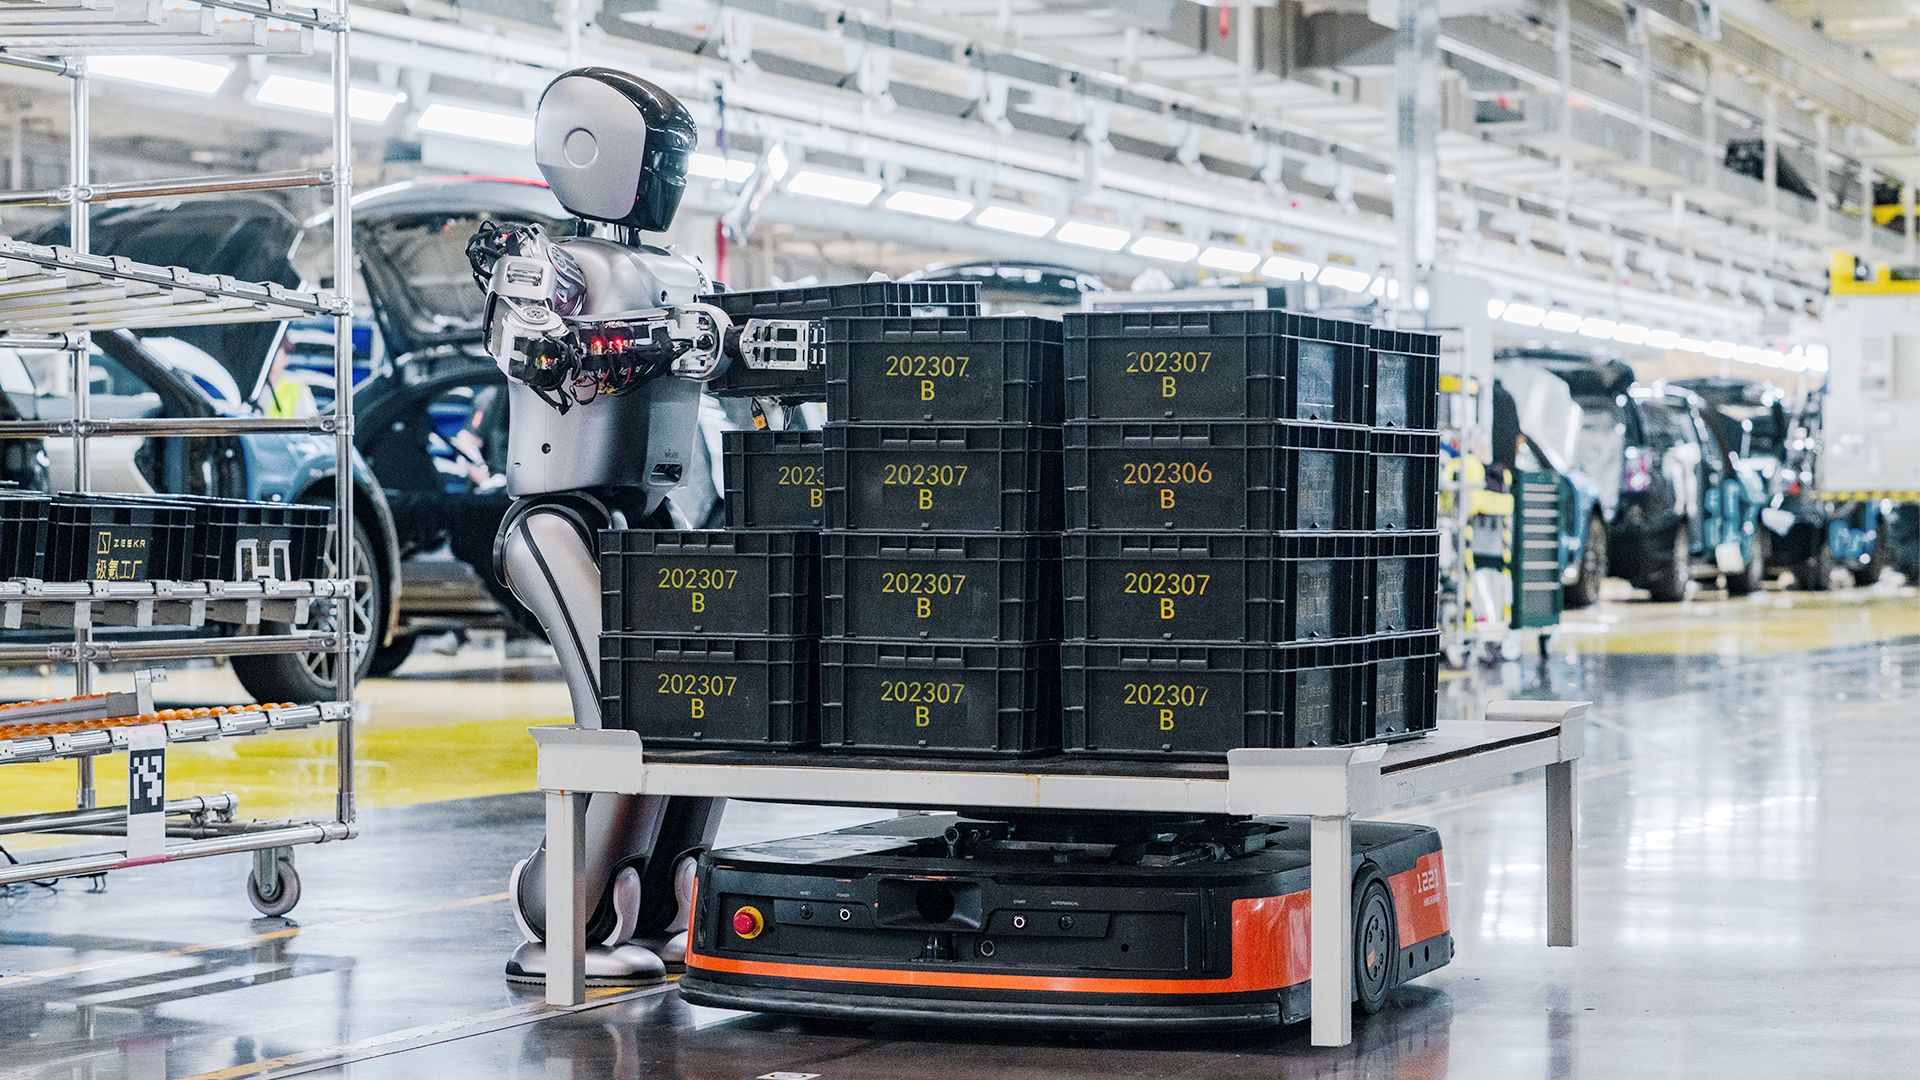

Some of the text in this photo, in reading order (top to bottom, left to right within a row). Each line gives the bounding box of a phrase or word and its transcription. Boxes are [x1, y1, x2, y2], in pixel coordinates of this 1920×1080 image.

[887, 356, 969, 376] 202307
[1127, 352, 1211, 372] 202307
[921, 380, 934, 400] B
[1163, 377, 1176, 397] B
[779, 466, 824, 485] 2023
[885, 465, 967, 485] 202307
[1124, 462, 1212, 484] 202306
[811, 488, 822, 507] B
[919, 489, 932, 509] B
[1161, 489, 1175, 508] B
[114, 539, 146, 548] ZEEKR
[96, 558, 143, 580] 极氪工厂
[659, 568, 737, 589] 202307
[882, 573, 965, 594] 202307
[1125, 573, 1210, 595] 202307
[692, 592, 705, 612] B
[917, 597, 931, 618] B
[1161, 598, 1174, 619] B
[659, 674, 736, 695] 202307
[881, 681, 964, 703] 202307
[1125, 684, 1206, 706] 202307
[691, 698, 704, 718] B
[916, 706, 929, 726] B
[1160, 709, 1174, 730] B
[1417, 868, 1439, 894] 1221
